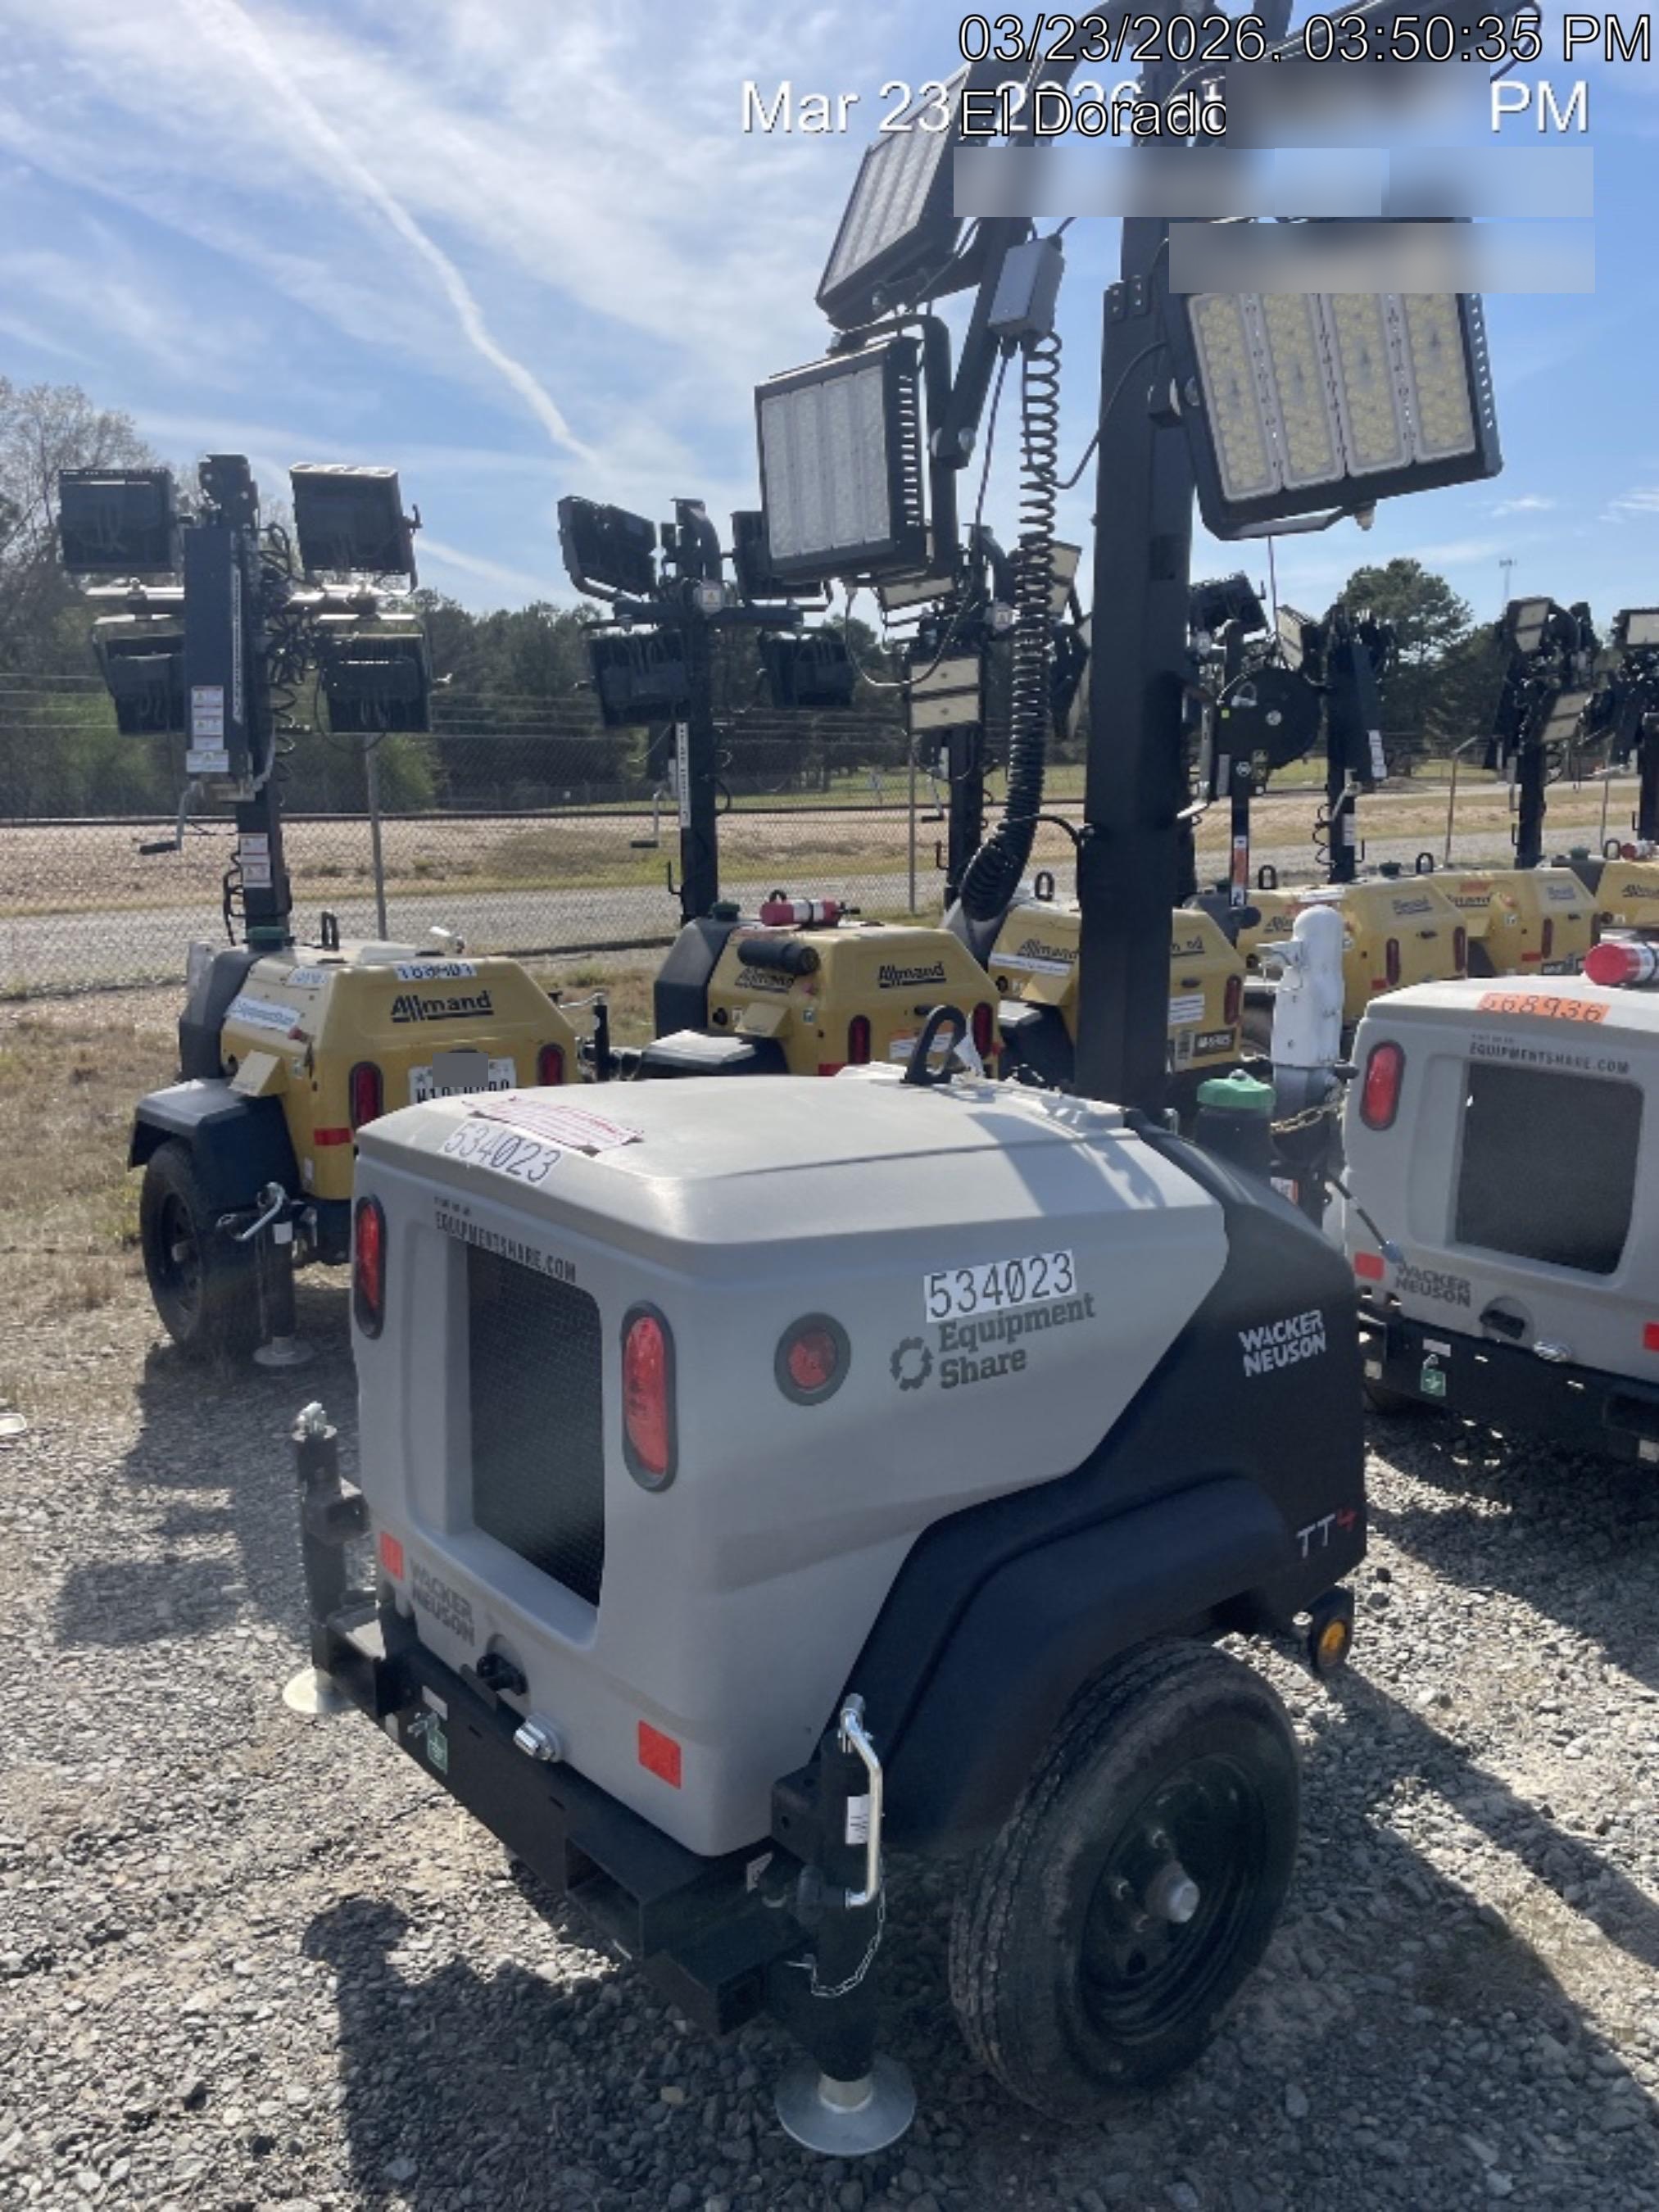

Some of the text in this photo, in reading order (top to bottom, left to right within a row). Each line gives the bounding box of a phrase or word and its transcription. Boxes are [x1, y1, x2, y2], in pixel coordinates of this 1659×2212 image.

[391, 990, 493, 1022] Allmand
[1470, 1041, 1630, 1074] EQUIPMENTSHARE.COM
[443, 1122, 561, 1183] 534023
[435, 1210, 576, 1284] EQUIPMENTSHARE.COM
[929, 1253, 1074, 1318] 534023
[939, 1291, 1095, 1354] Equipment
[1238, 1309, 1324, 1353] WACKER
[940, 1348, 1027, 1389] Share
[1243, 1330, 1326, 1378] NEUSON
